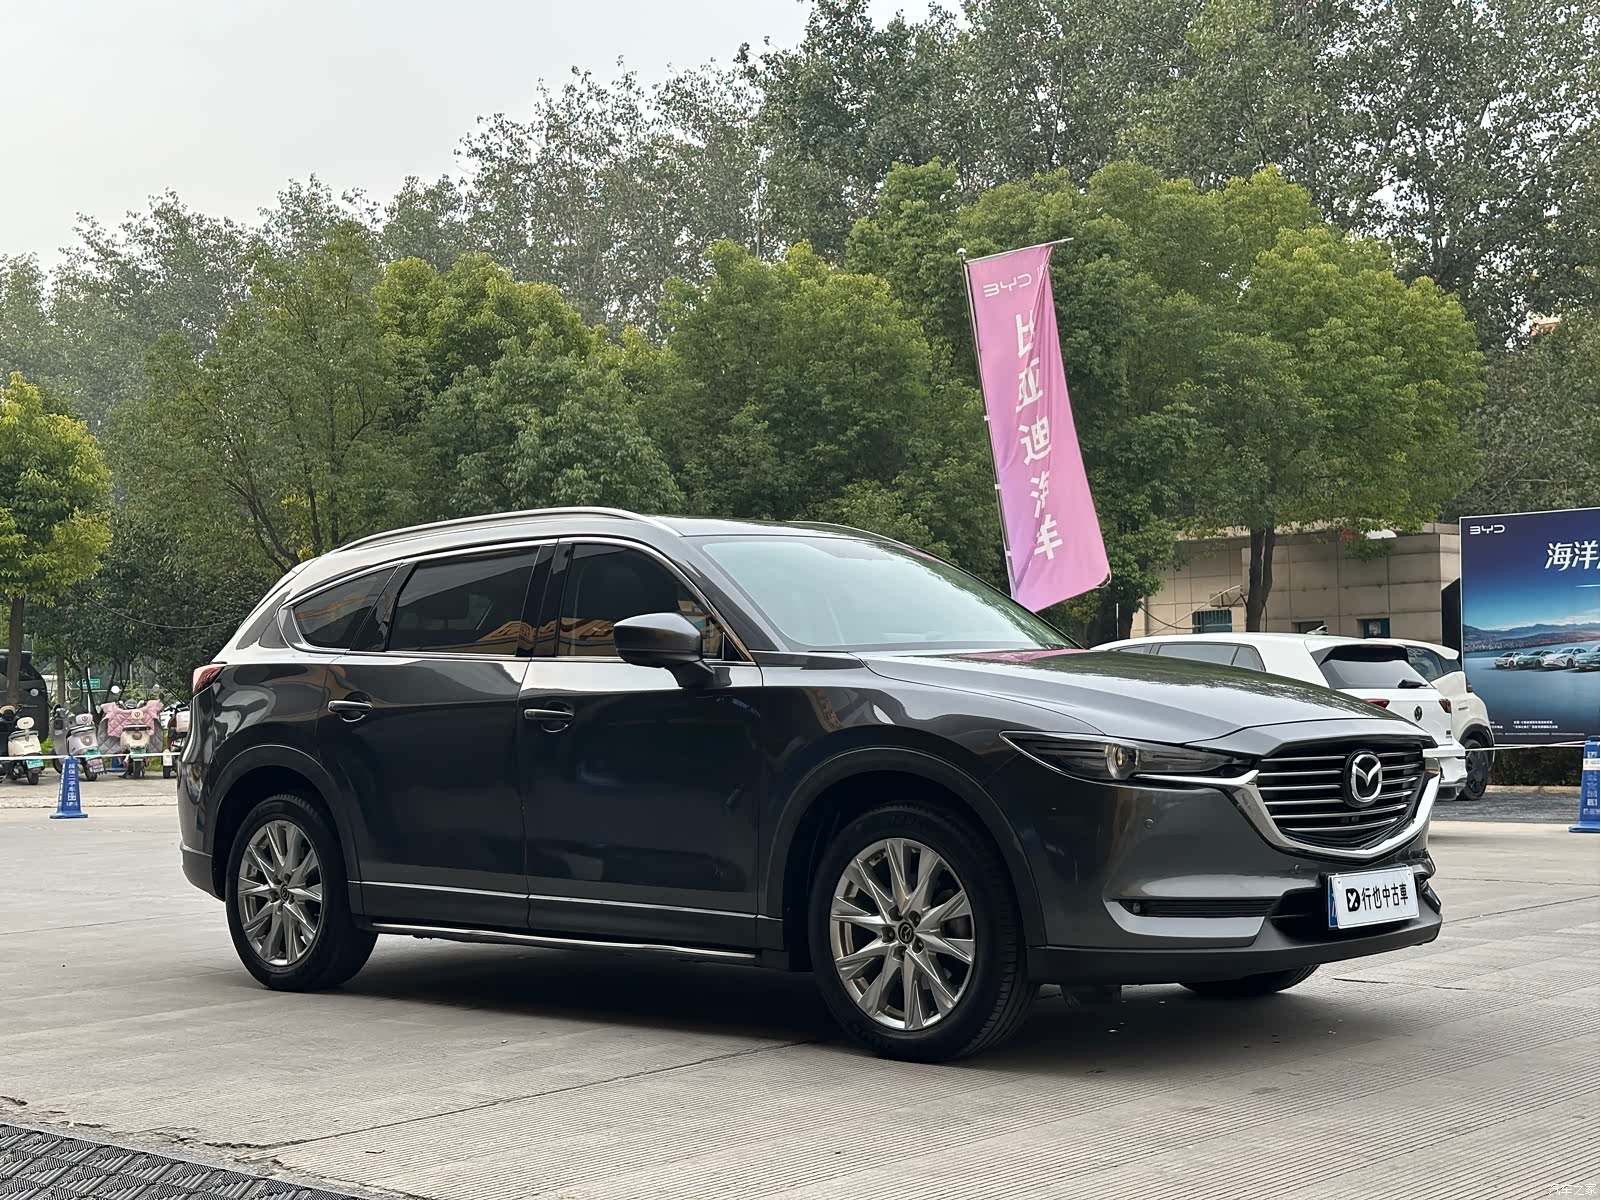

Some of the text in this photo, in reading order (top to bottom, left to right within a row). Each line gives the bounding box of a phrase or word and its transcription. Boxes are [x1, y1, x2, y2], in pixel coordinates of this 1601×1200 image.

[983, 273, 1032, 297] BYD
[1469, 524, 1505, 535] BYD
[1545, 540, 1600, 571] 海洋
[1361, 882, 1409, 911] 行也中古車
